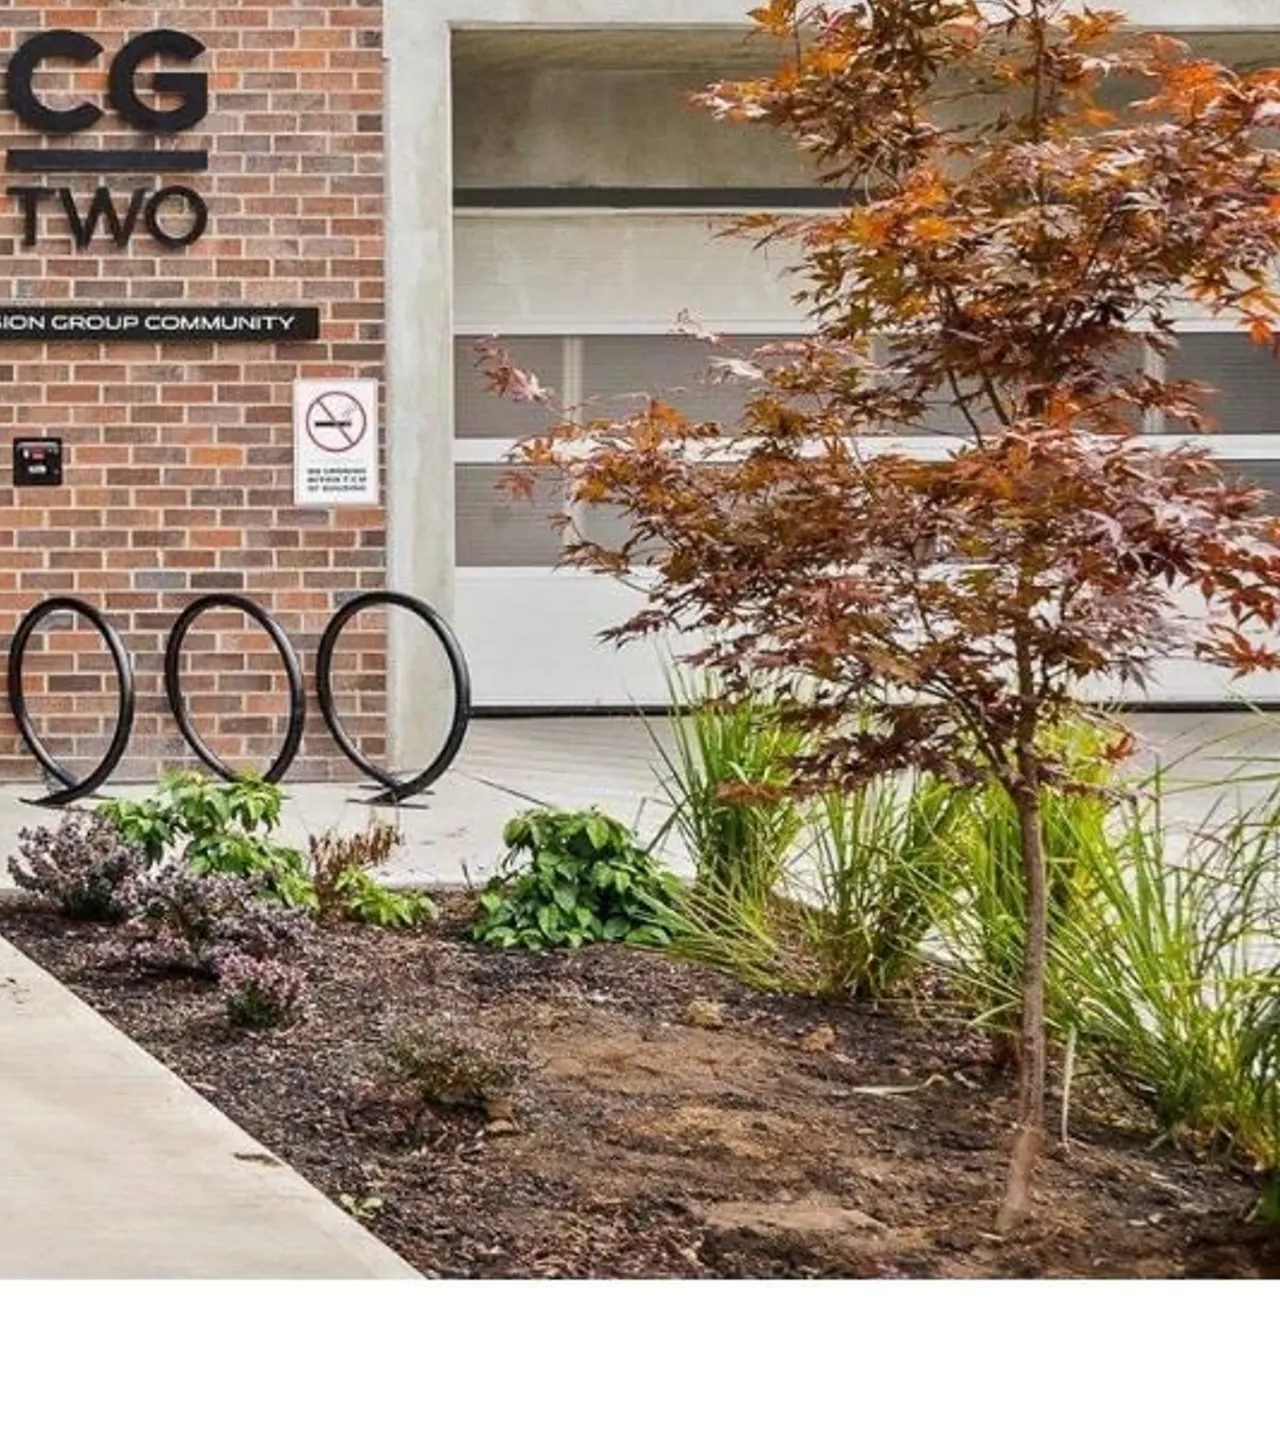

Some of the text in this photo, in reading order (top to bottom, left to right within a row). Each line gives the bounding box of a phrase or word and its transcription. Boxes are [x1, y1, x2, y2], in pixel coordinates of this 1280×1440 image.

[7, 29, 208, 135] CG
[6, 185, 208, 250] TWO
[50, 315, 139, 331] GROUP
[144, 315, 296, 331] COMMUNITY
